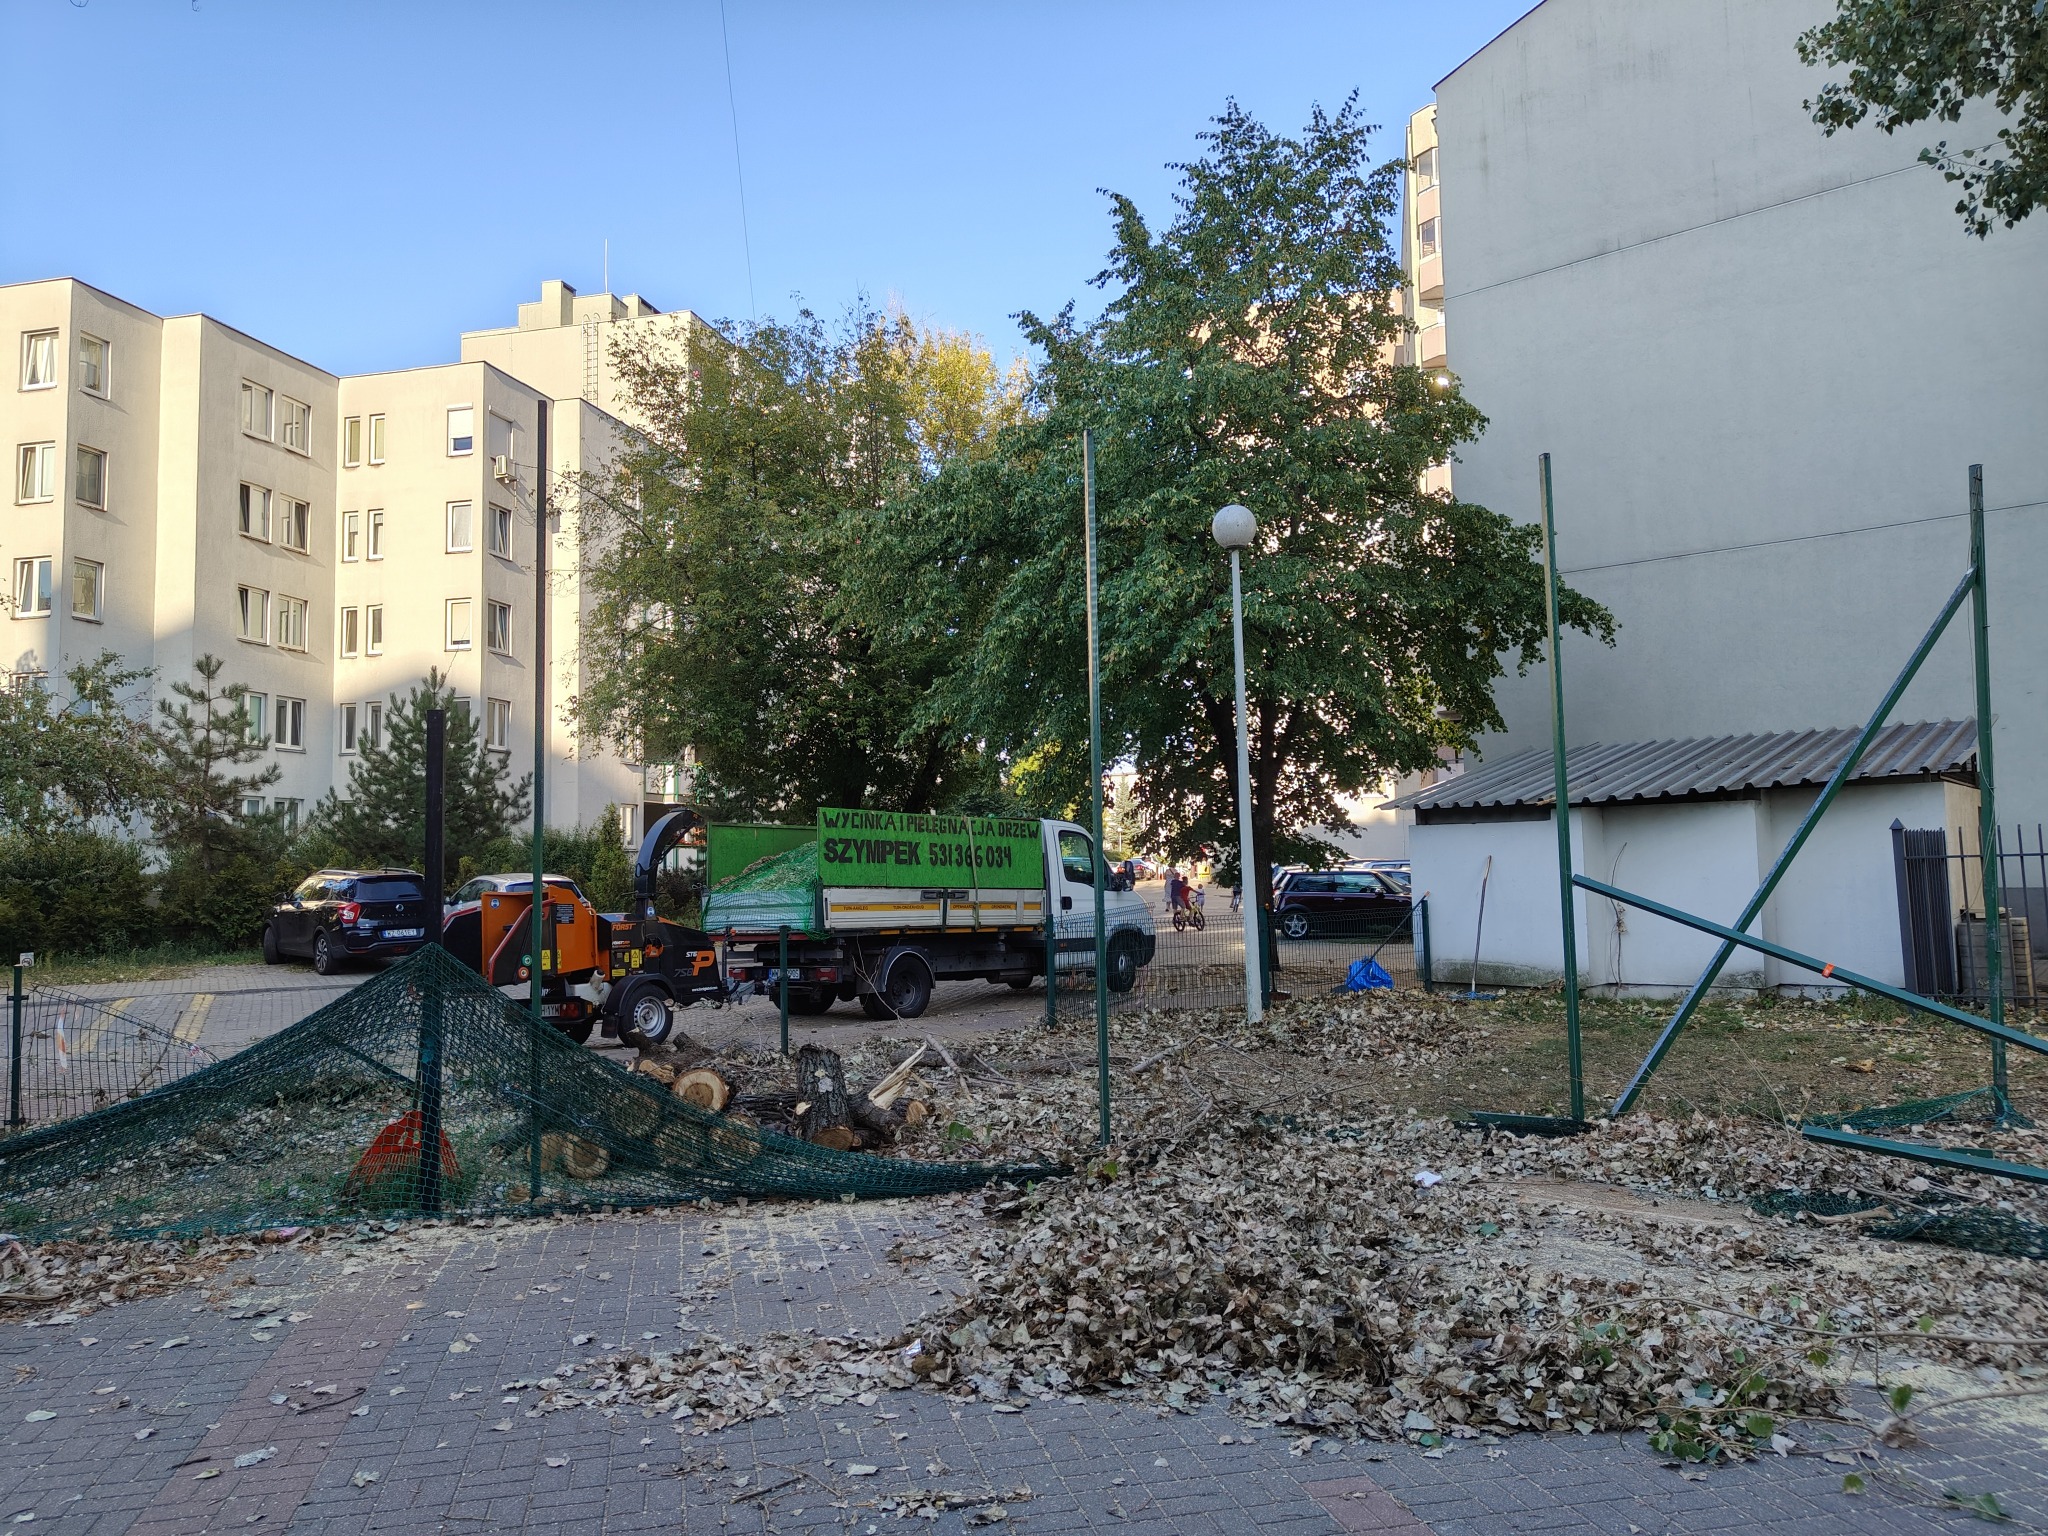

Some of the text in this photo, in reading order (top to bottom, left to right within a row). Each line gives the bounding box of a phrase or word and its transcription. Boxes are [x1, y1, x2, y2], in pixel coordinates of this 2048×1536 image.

[822, 811, 896, 831] WYCINKA
[899, 815, 904, 831] I
[998, 821, 1040, 839] DRZEW
[823, 837, 922, 866] SZYMPEK
